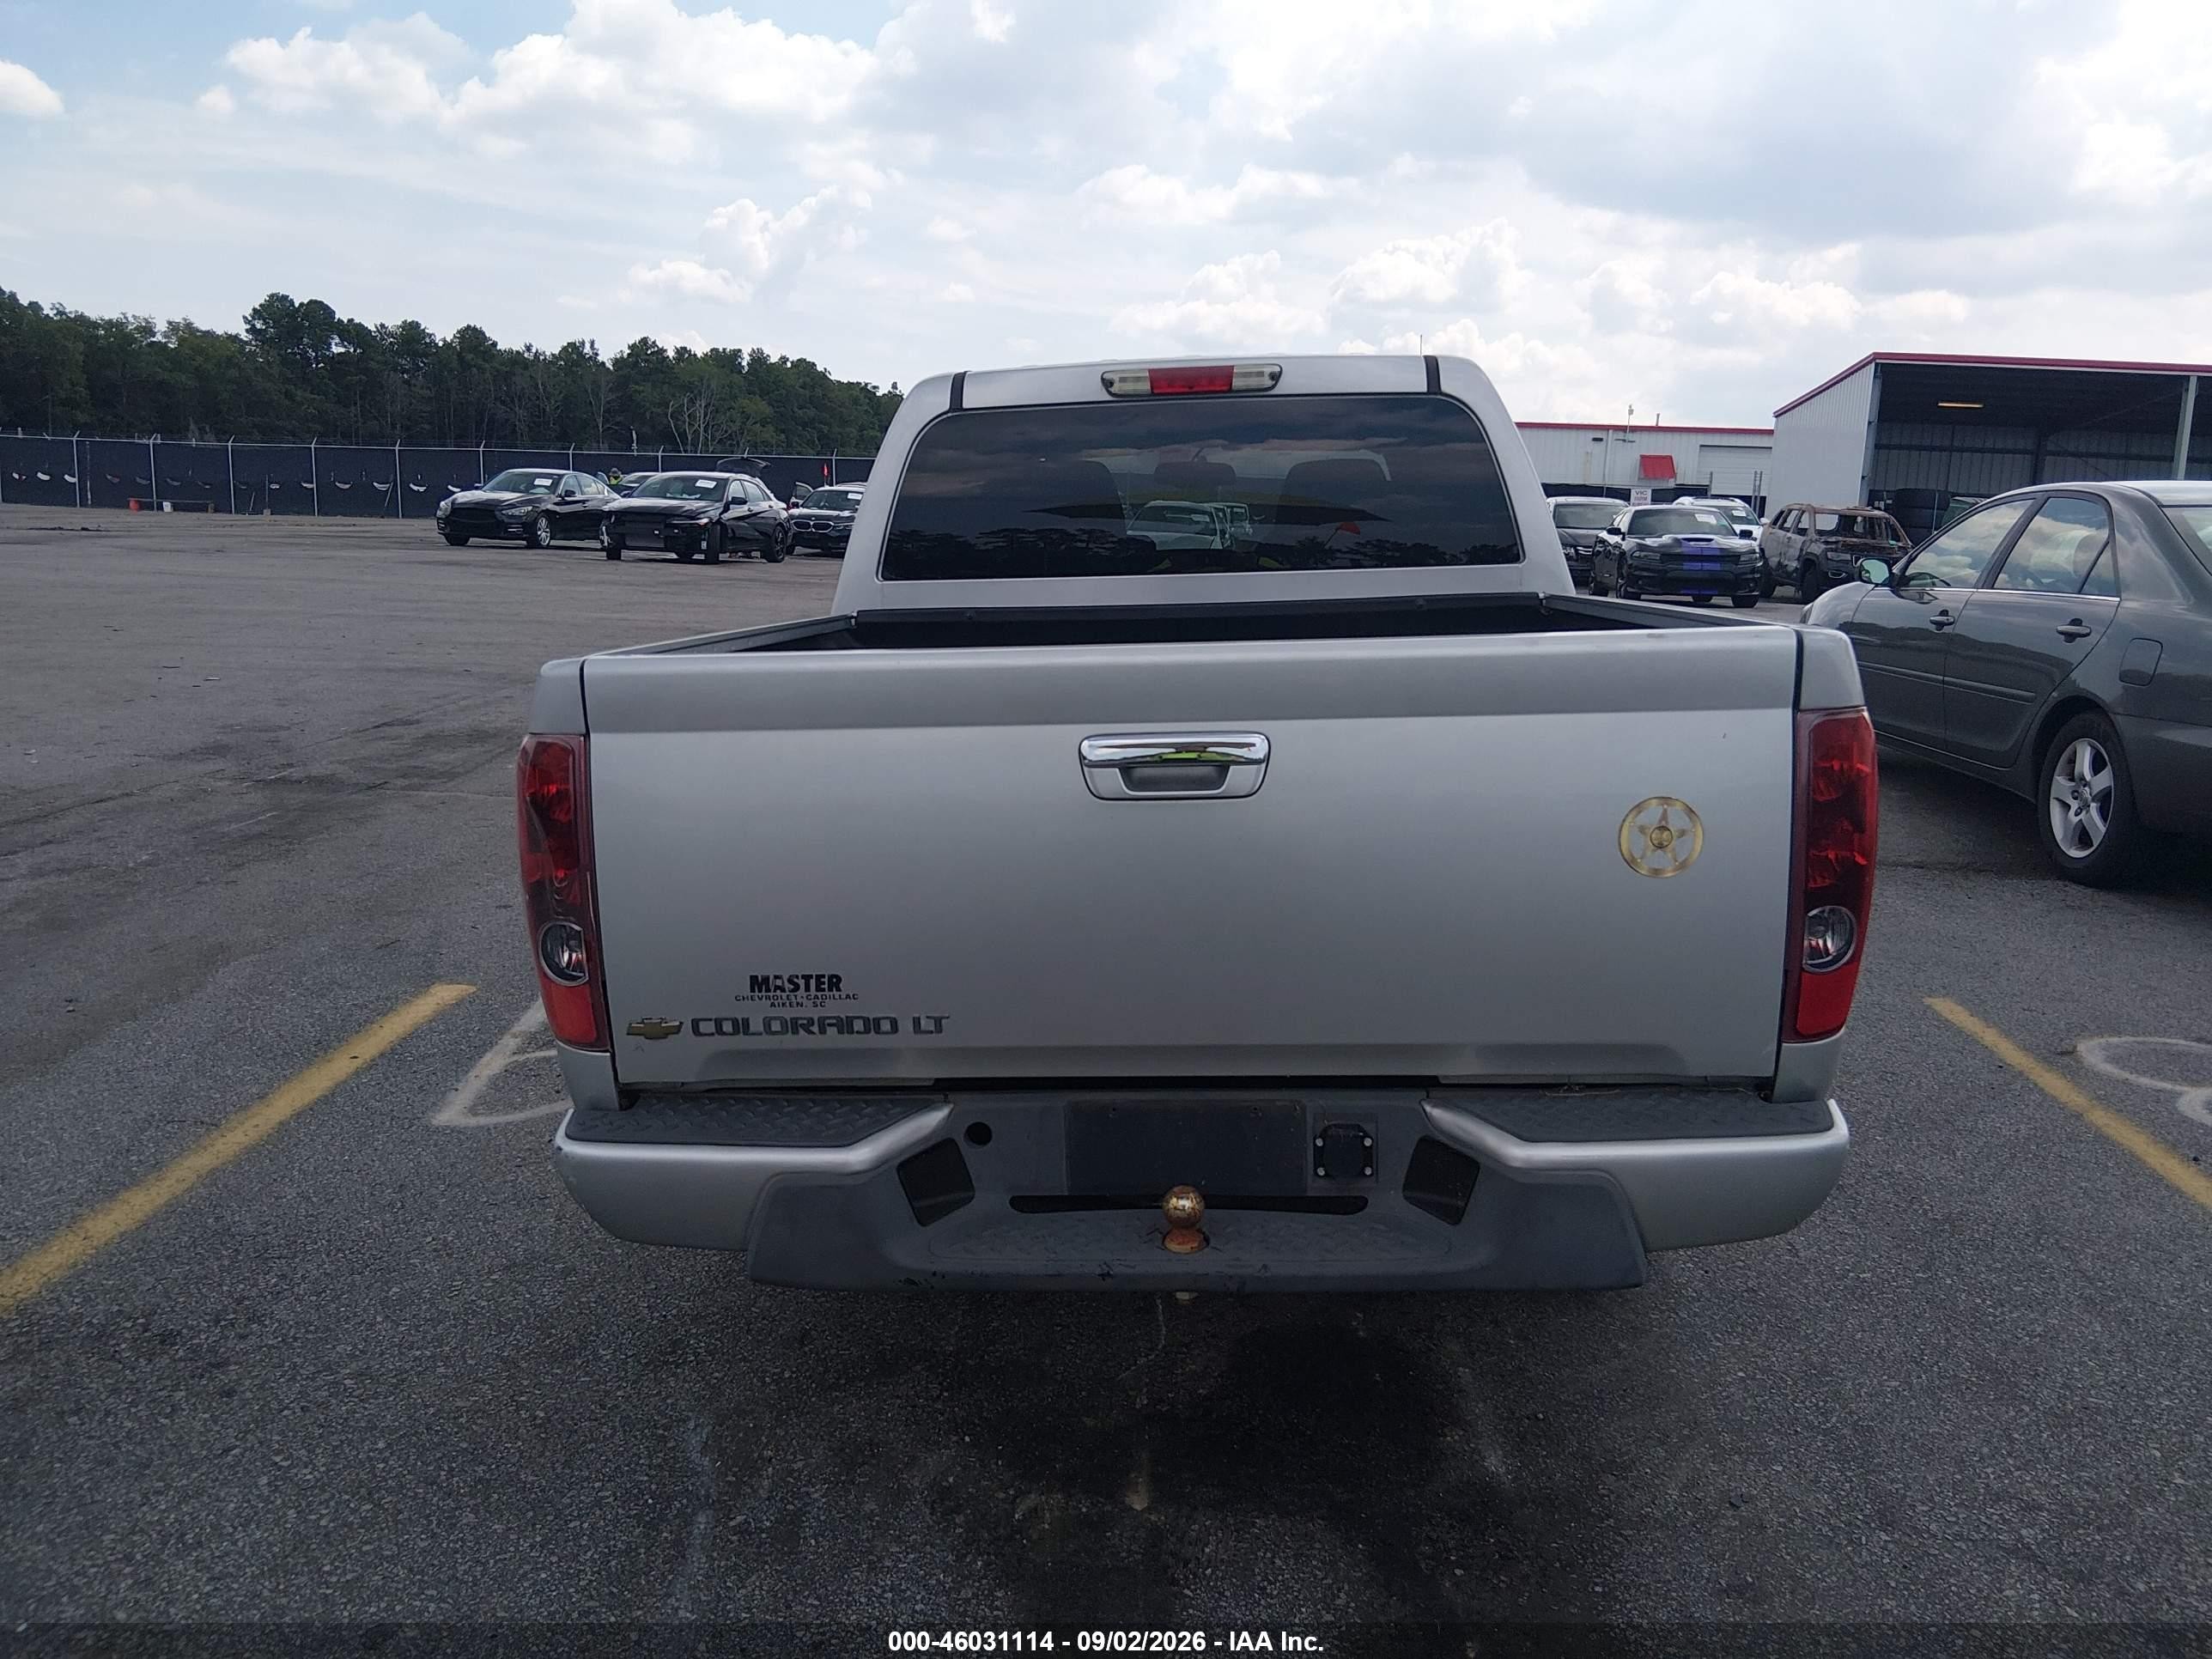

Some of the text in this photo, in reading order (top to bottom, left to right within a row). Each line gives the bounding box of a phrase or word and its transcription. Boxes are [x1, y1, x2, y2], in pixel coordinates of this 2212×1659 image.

[749, 974, 842, 994] MASTER
[690, 1014, 951, 1037] COLORADO LT
